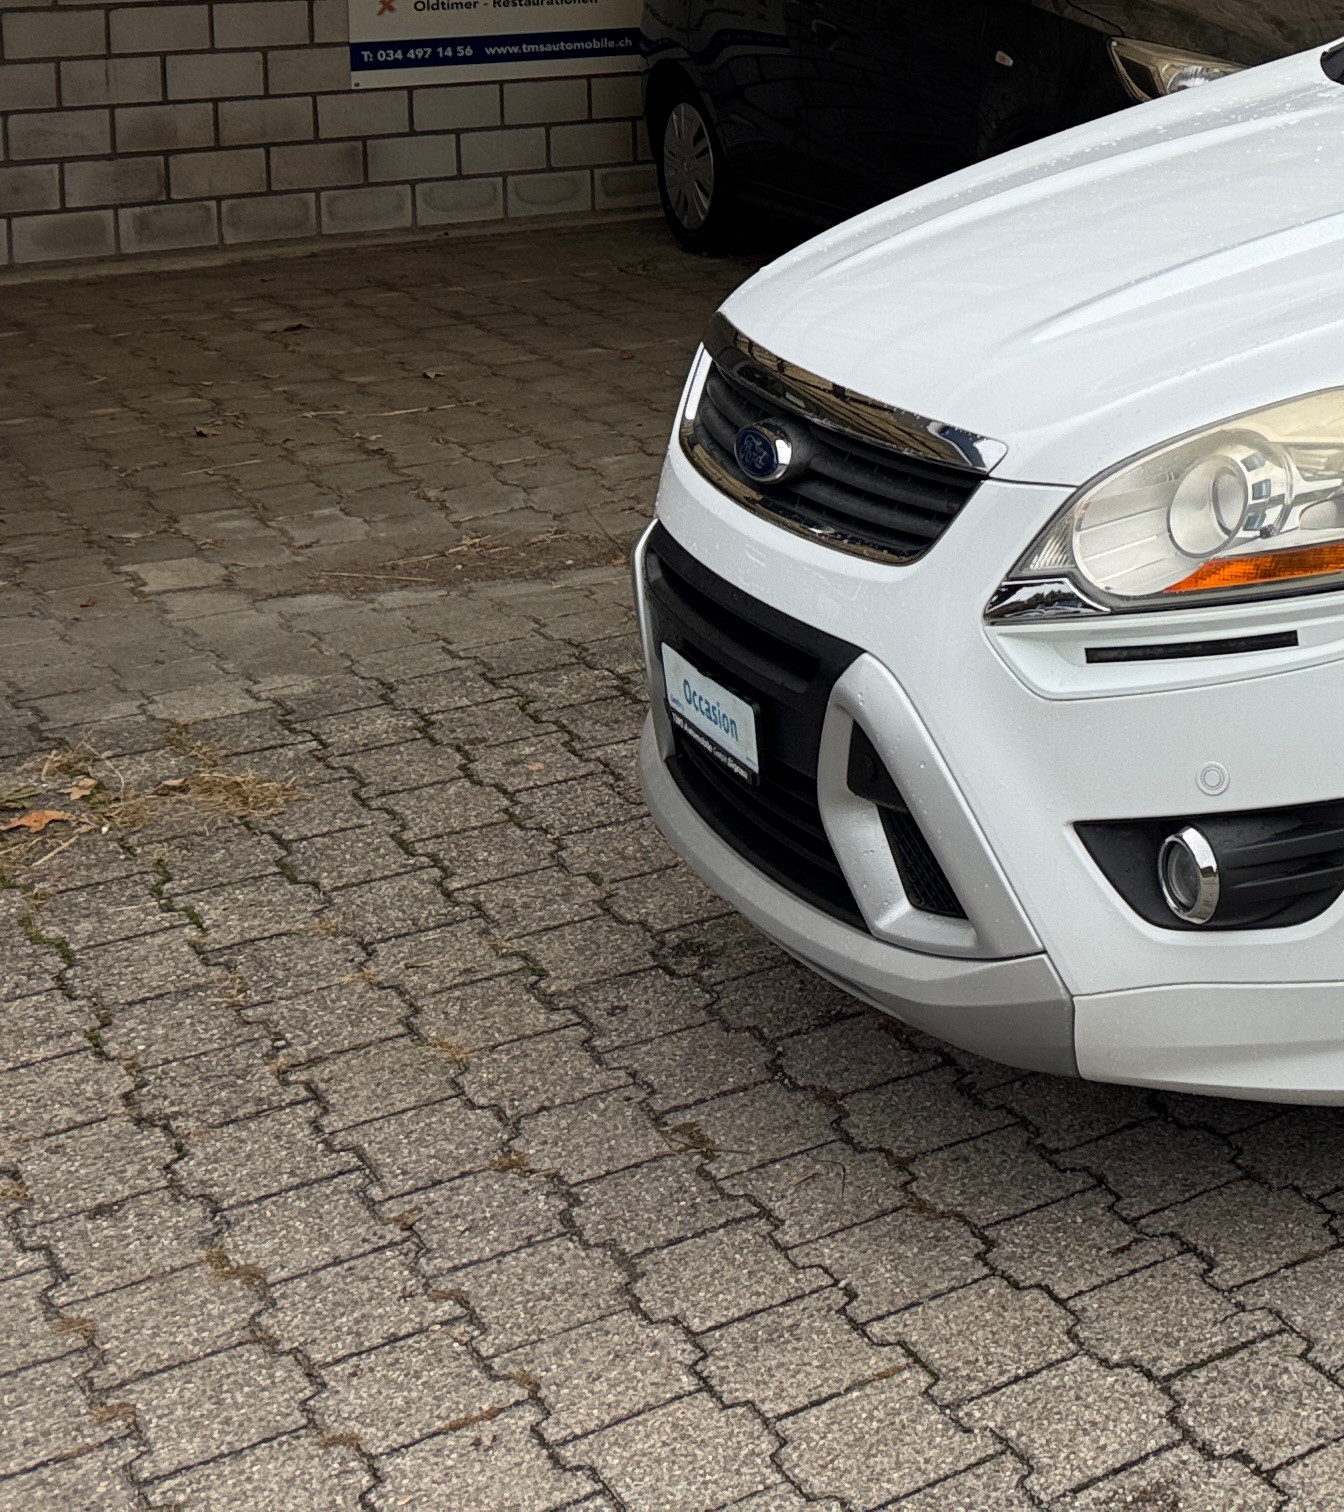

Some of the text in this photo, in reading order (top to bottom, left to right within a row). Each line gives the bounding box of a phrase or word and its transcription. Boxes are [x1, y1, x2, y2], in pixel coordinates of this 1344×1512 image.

[377, 49, 403, 62] 034
[406, 47, 432, 60] 497
[436, 46, 454, 58] 14
[456, 45, 474, 57] 56
[484, 36, 633, 55] www.tmsautomobile.ch
[682, 677, 739, 743] Occasion
